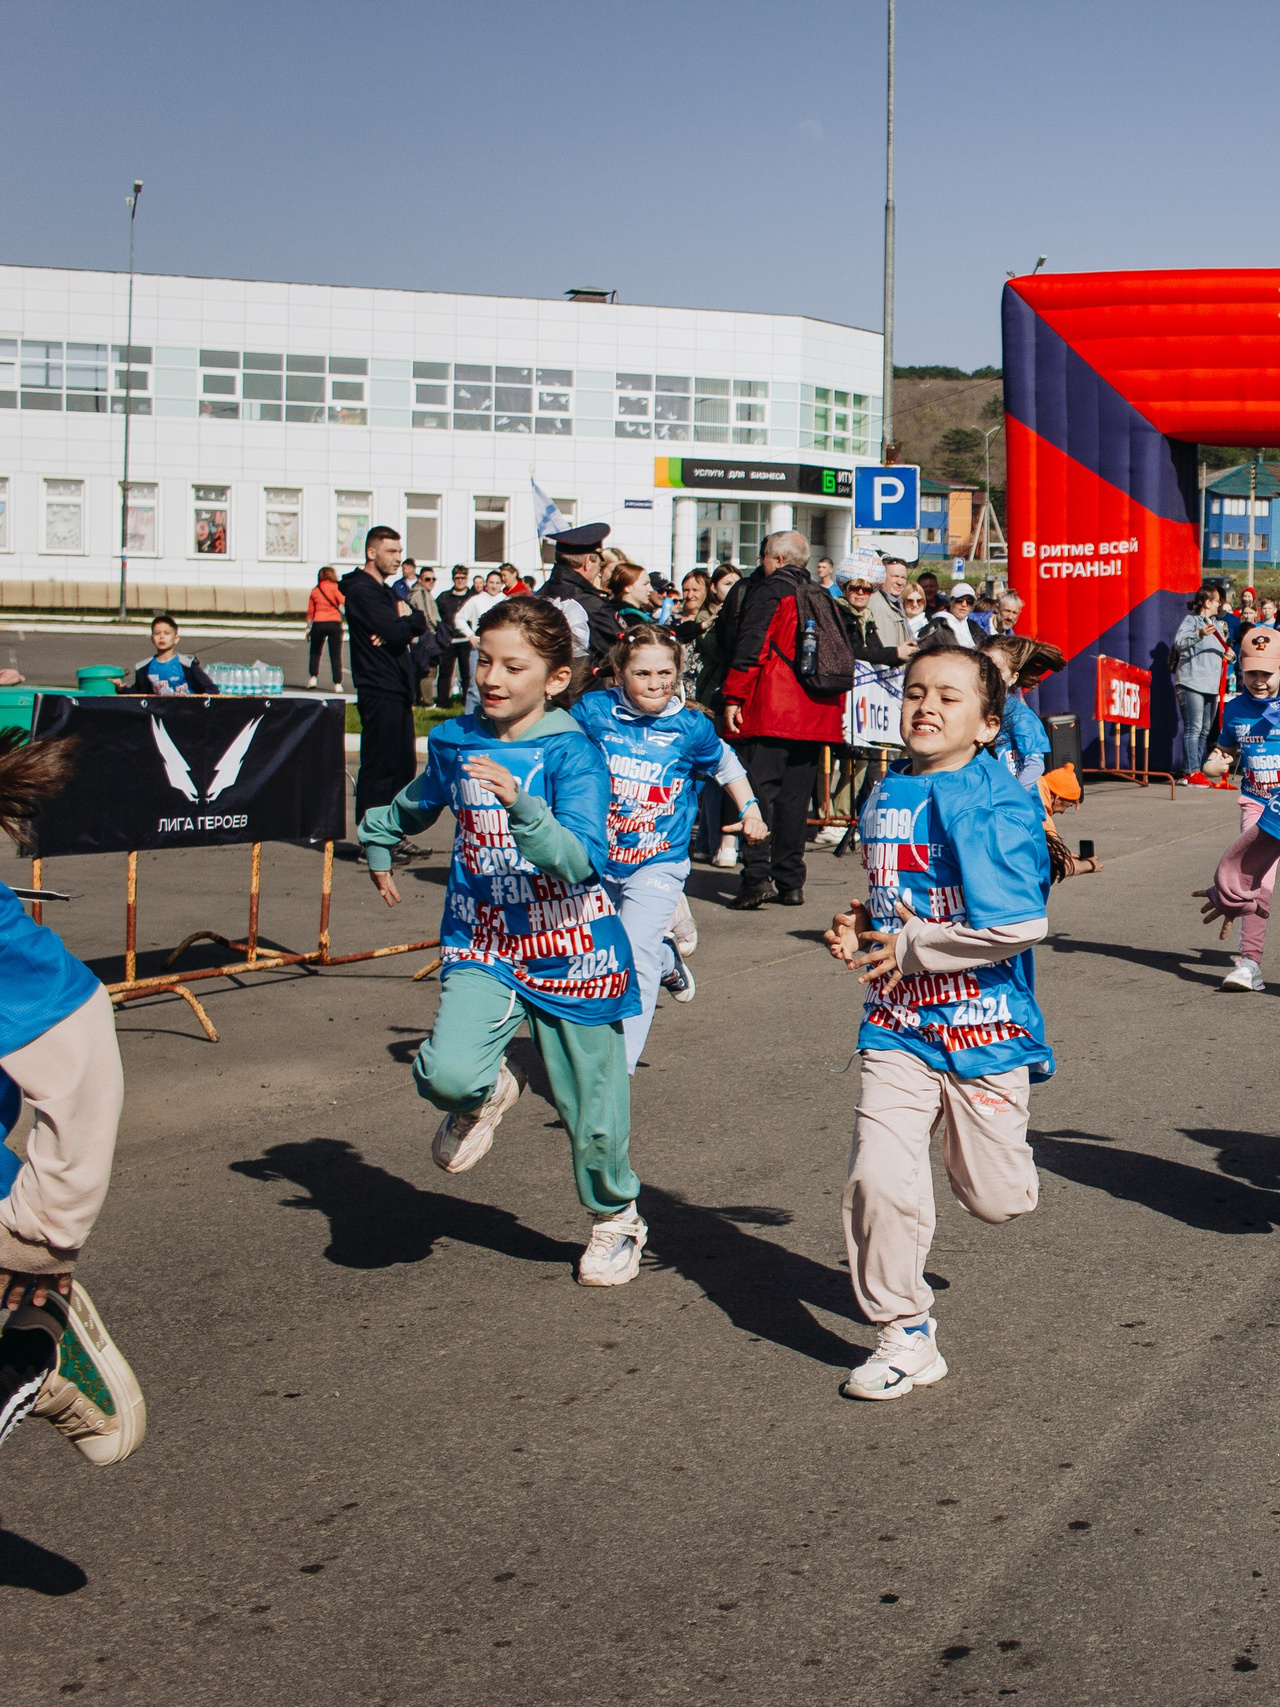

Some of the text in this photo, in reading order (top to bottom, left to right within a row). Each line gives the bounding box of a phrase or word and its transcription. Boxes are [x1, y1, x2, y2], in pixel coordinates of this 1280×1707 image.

[694, 468, 787, 481] УСЛУГИ ДЛЯ БИЗНЕСА
[1022, 537, 1138, 560] В ритме всей
[1039, 560, 1121, 579] СТРАНЫ!
[870, 703, 889, 731] ПСБ
[609, 754, 662, 783] 00502
[1248, 755, 1280, 769] 00503
[613, 779, 651, 802] 500М
[158, 814, 248, 832] ЛИГА ГЕРОЕВ
[646, 878, 670, 891] FILA
[470, 923, 595, 960] #ГОРДОСТЬ
[568, 945, 619, 979] 2024
[953, 993, 1012, 1025] 2024
